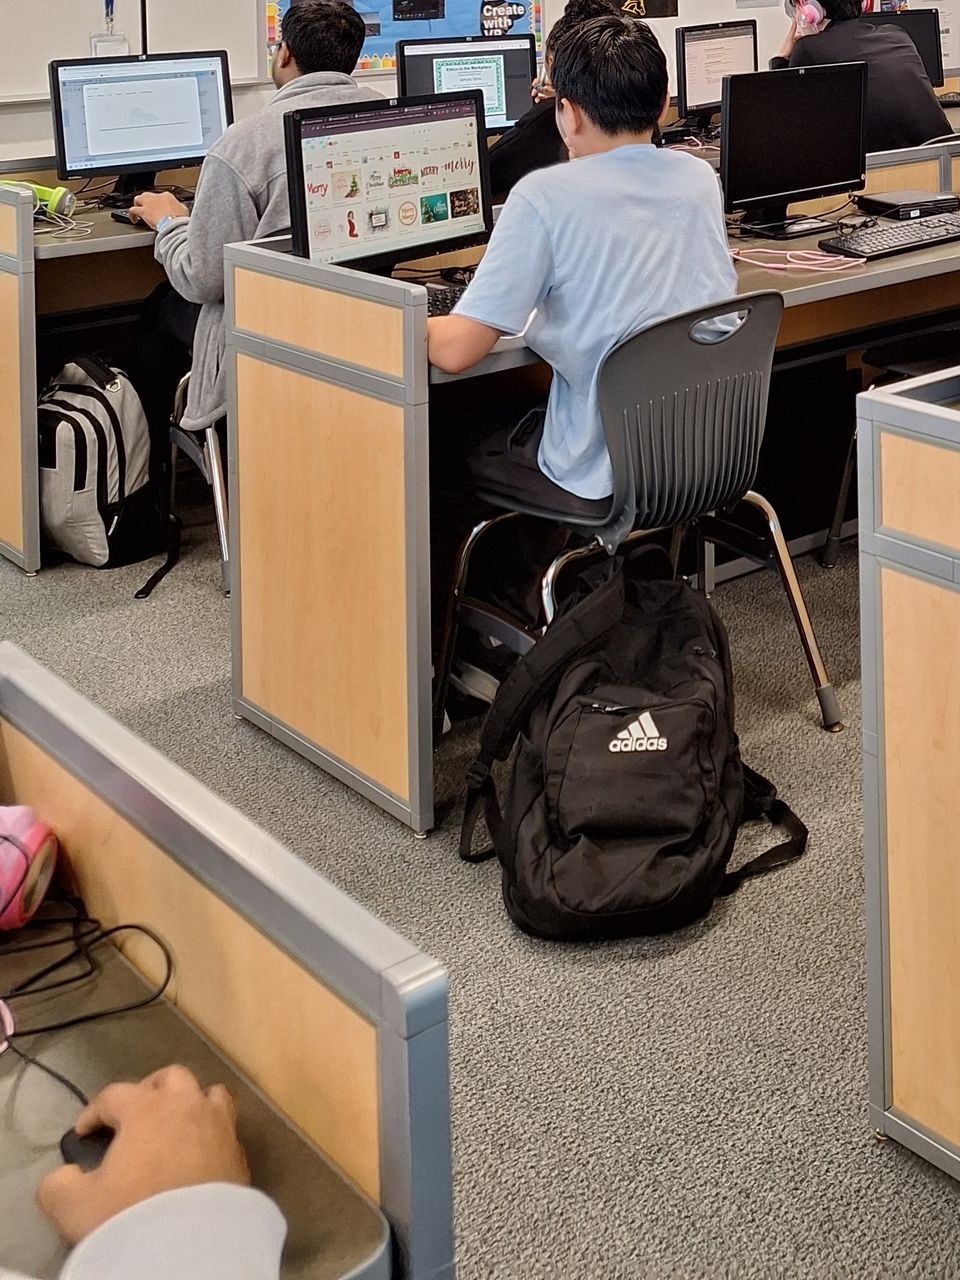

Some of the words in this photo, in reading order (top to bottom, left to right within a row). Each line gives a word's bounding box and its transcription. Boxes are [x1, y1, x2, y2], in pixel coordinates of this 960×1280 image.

[483, 5, 525, 16] Create
[483, 17, 512, 29] with
[608, 736, 668, 752] adidas
